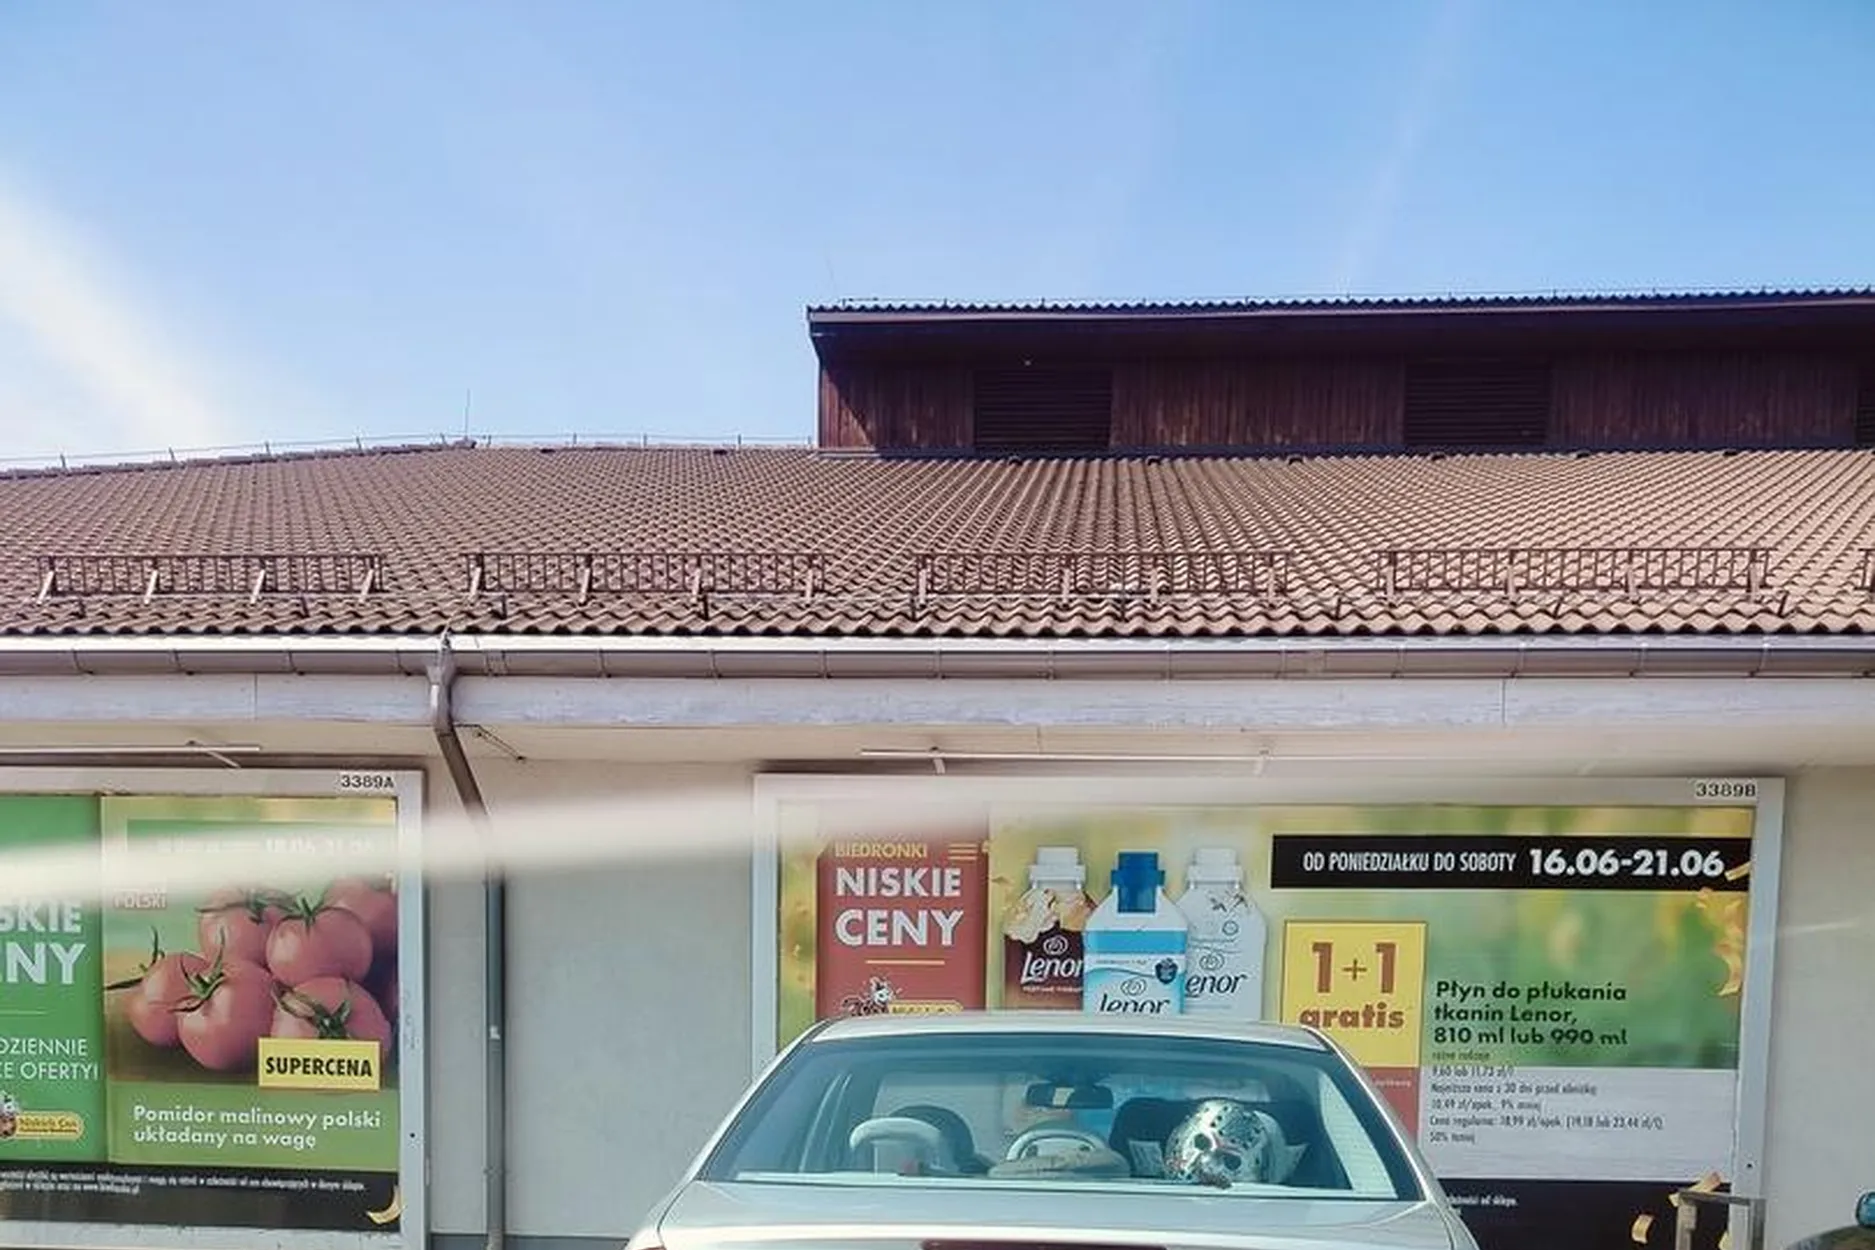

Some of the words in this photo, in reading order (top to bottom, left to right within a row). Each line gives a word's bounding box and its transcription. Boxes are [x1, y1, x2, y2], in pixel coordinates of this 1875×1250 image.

[341, 774, 395, 789] 3389A
[1695, 782, 1756, 797] 3389B
[834, 842, 928, 858] BIEDRONKI
[1303, 852, 1324, 871] OD
[1328, 852, 1429, 872] PONIEDZIAŁKU
[1434, 853, 1455, 872] DO
[1459, 853, 1517, 872] SOBOTY
[1529, 848, 1726, 878] 16.06-21.06
[835, 867, 962, 898] NISKIE
[113, 889, 168, 909] POLSKI
[834, 908, 965, 947] CENY
[0, 941, 86, 985] NY
[1186, 973, 1248, 998] enor
[1436, 980, 1486, 1003] Płyn
[1492, 981, 1521, 999] do
[1527, 981, 1627, 1004] płukania
[1434, 1003, 1504, 1022] tkanin
[1510, 1005, 1578, 1025] Lenor,
[1434, 1027, 1472, 1044] 810
[1477, 1027, 1504, 1044] ml
[1511, 1028, 1545, 1045] lub
[1551, 1029, 1595, 1045] 990
[1600, 1029, 1628, 1046] ml
[265, 1056, 374, 1078] SUPERCENA
[133, 1105, 215, 1124] Pomidor
[219, 1107, 318, 1131] malinowy
[322, 1110, 382, 1131] polski
[133, 1125, 228, 1150] układany
[232, 1131, 259, 1147] na
[262, 1132, 317, 1151] wagę
